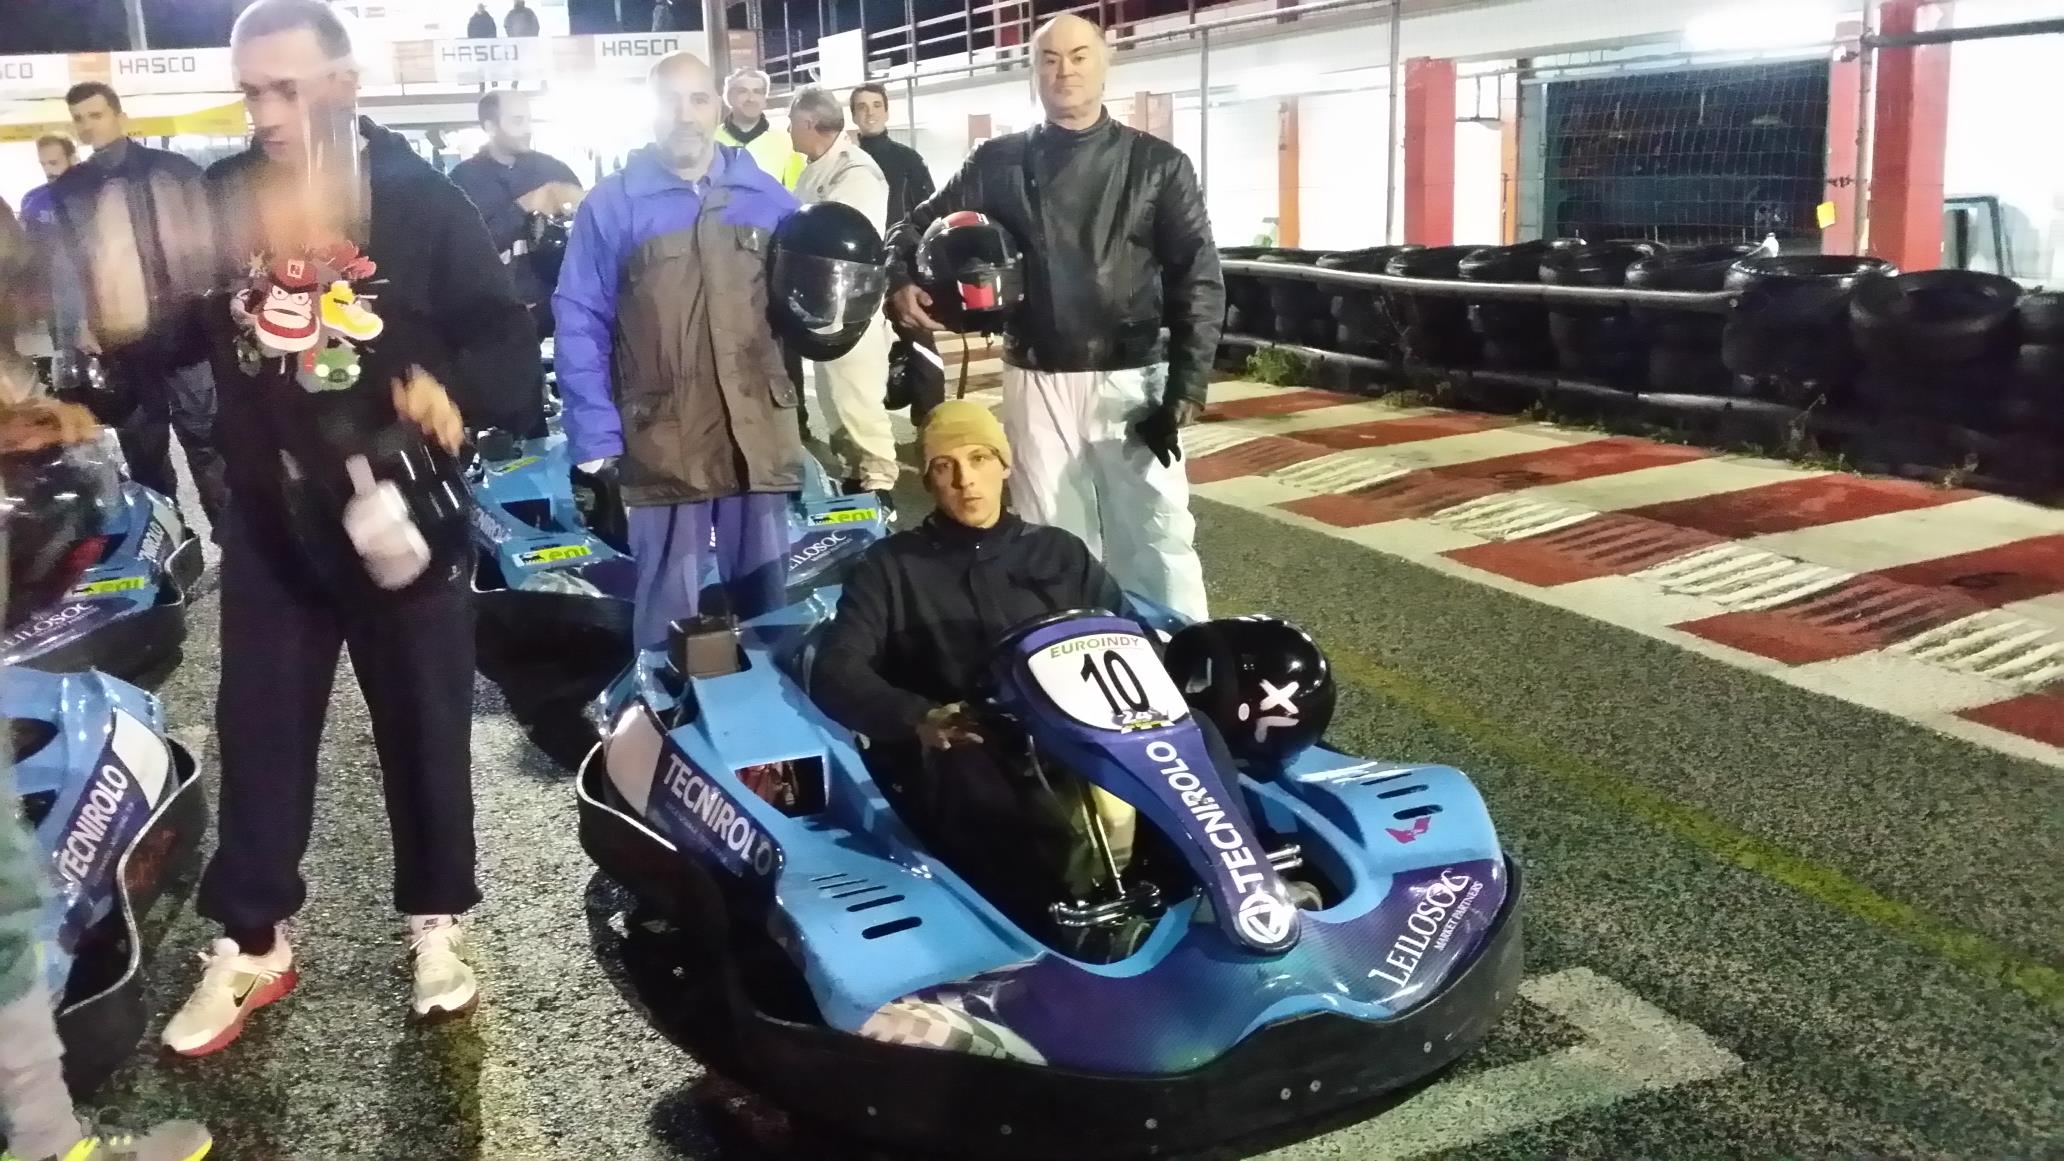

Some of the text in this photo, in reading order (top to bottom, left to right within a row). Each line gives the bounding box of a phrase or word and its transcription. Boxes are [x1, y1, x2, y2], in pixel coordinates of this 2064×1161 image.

[0, 62, 34, 80] CO
[119, 56, 196, 75] HASCO
[442, 44, 519, 62] HASCO
[602, 38, 679, 56] HASCO
[1050, 636, 1140, 659] EUROINDY
[1080, 649, 1150, 715] 10
[58, 764, 128, 888] TECNIROLO
[664, 753, 773, 876] TECNIROLO
[1146, 741, 1264, 894] TECNIROLO
[1367, 867, 1472, 988] LEILOSOC
[1434, 880, 1484, 951] MARKET PARTNERS
